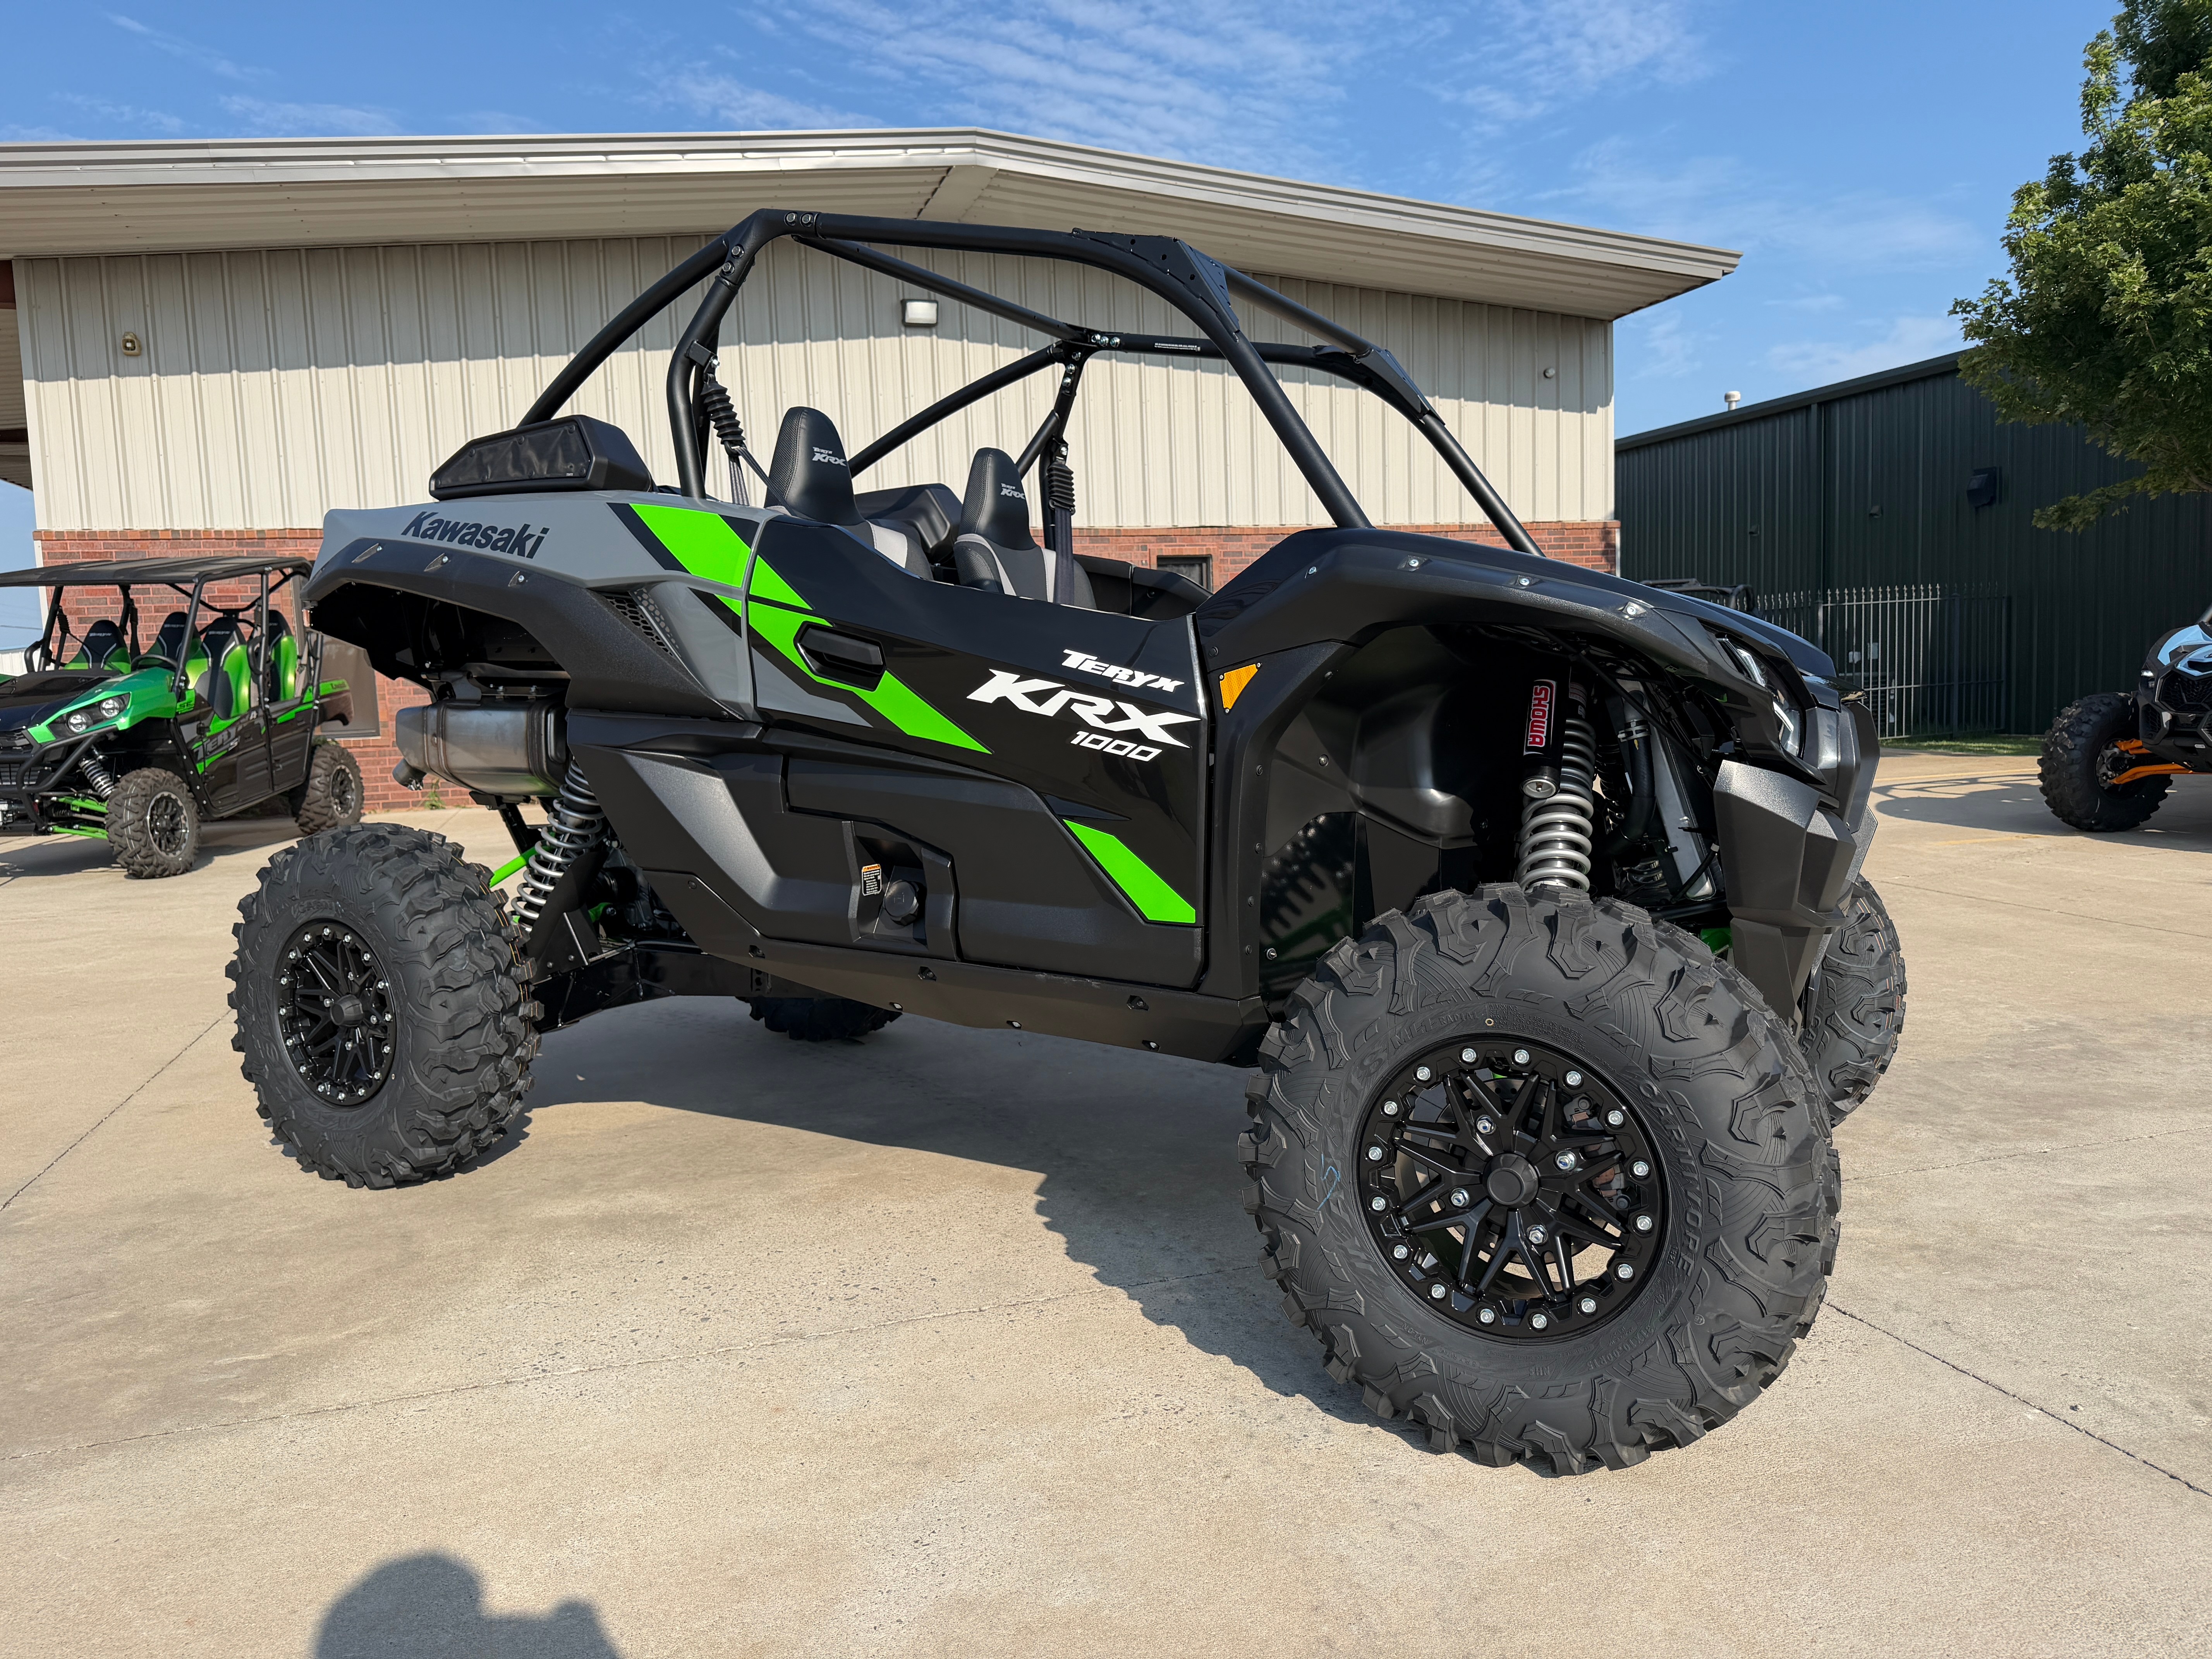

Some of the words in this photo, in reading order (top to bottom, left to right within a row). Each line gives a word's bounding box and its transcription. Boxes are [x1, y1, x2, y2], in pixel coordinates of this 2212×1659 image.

[812, 453, 848, 467] KRX
[1001, 489, 1025, 500] KRX
[401, 512, 550, 559] Kawasaki
[1062, 649, 1185, 692] TERYX
[967, 668, 1202, 749] KRX
[1527, 685, 1551, 747] SHOWA
[1070, 731, 1162, 762] 1000
[1439, 1011, 1479, 1026] RADIAL
[1489, 1003, 1518, 1011] WARNING
[1401, 1322, 1428, 1345] NYLON
